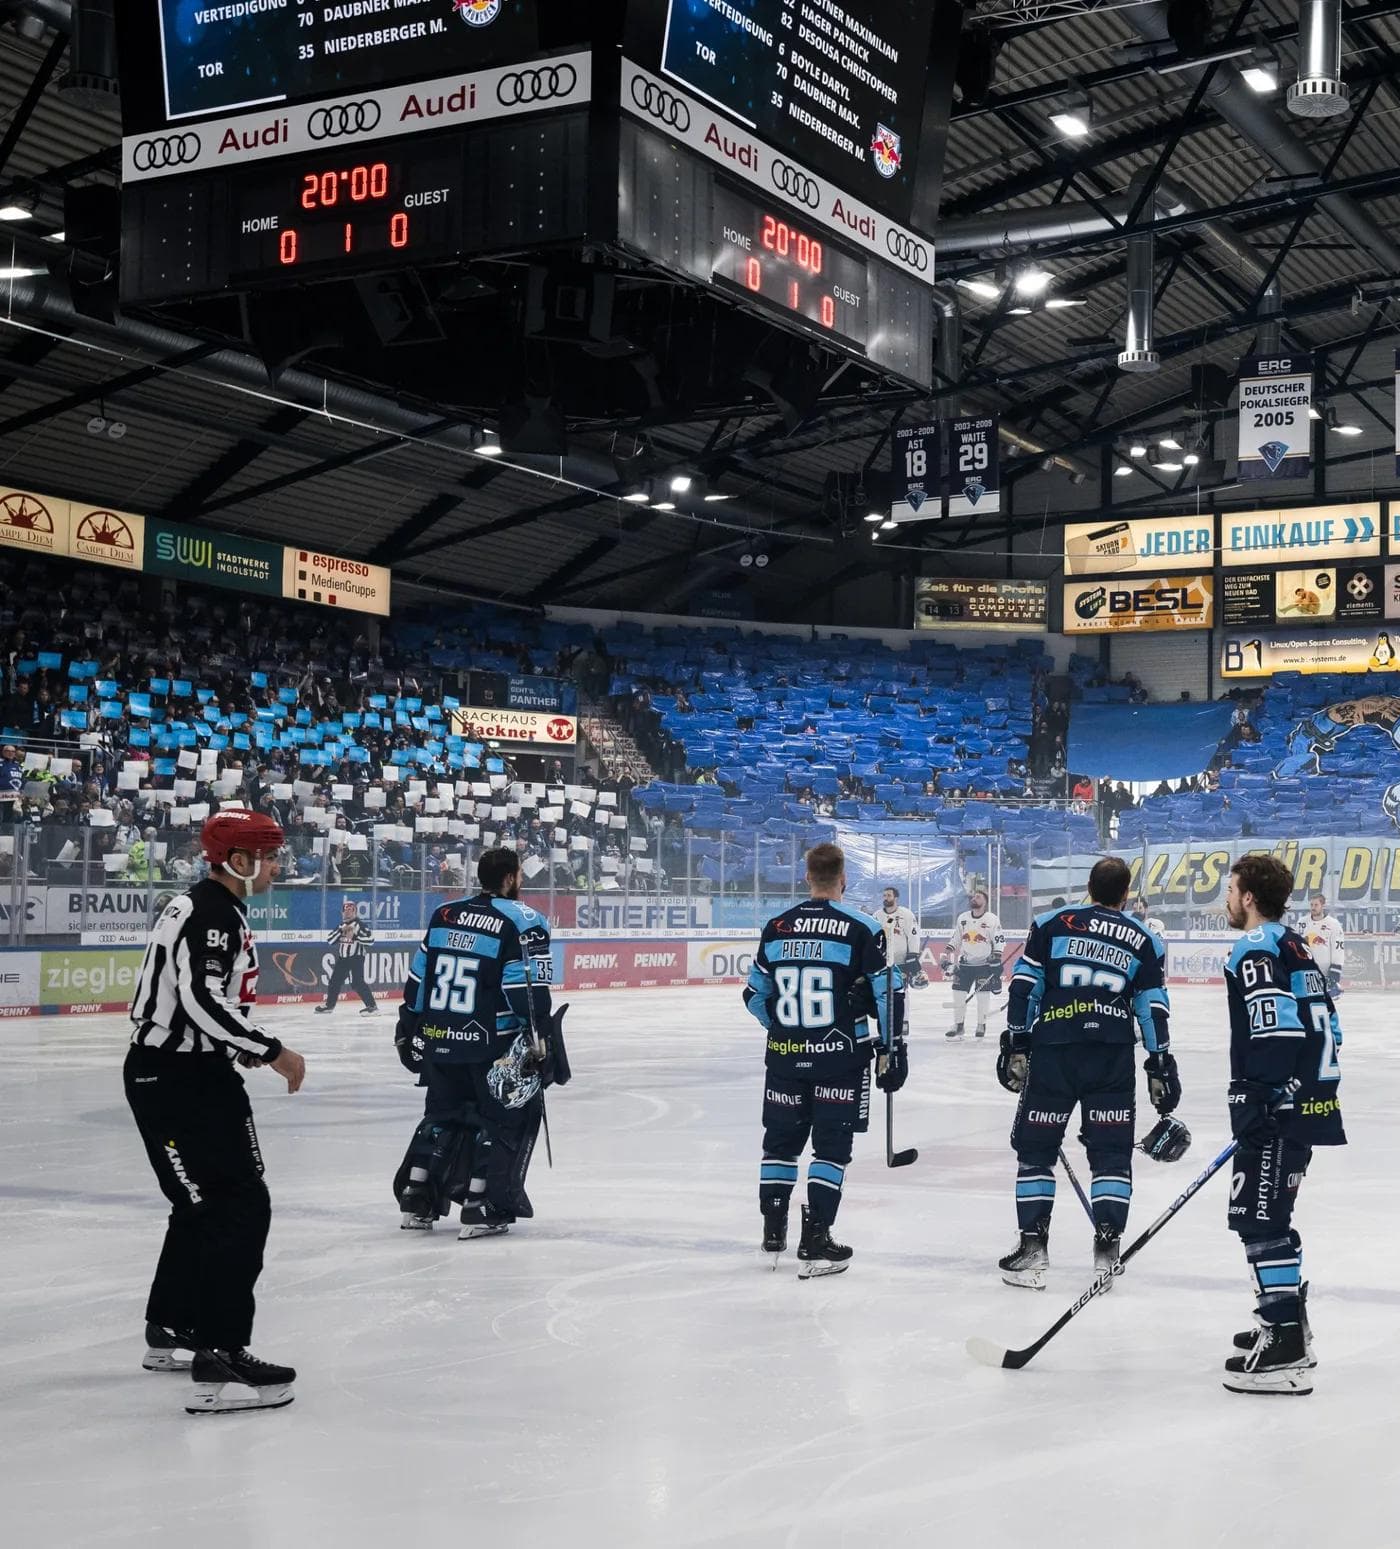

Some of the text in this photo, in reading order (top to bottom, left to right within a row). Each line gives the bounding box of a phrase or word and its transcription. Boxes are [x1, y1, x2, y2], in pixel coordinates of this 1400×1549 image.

[195, 0, 288, 24] VERTEIDIGUNG
[298, 12, 314, 27] 70
[324, 0, 391, 22] DAUBNER
[299, 18, 447, 60] 35 NIEDERBERGER M.
[801, 4, 869, 63] HAGER PATRICK
[845, 14, 898, 64] MAXIMILIAN
[696, 42, 716, 65] TOR
[781, 12, 898, 104] 82 DESOUSA CHRISTOPHER
[198, 61, 224, 78] TOR
[778, 43, 850, 101] 6 BOYLE DARYL
[400, 83, 477, 121] Audi
[776, 63, 861, 129] 70 DAUBNER MAX.
[218, 118, 290, 154] Audi
[771, 91, 866, 162] 35 NIEDERBERGER M.
[704, 123, 758, 172] Audi
[404, 189, 449, 208] GUEST
[242, 216, 279, 234] HOME
[832, 199, 876, 241] Audi
[281, 213, 408, 264] 0 1 0
[724, 226, 751, 250] HOME
[749, 258, 760, 291] 0
[822, 296, 835, 328] 0
[833, 285, 860, 308] GUEST
[1258, 359, 1292, 371] ERC
[1245, 382, 1305, 396] DEUTSCHER
[1240, 396, 1309, 410] POKALSIEGER
[1254, 412, 1294, 427] 2005
[908, 439, 924, 450] AST
[961, 432, 986, 443] WAITE
[905, 450, 927, 478] 18
[959, 443, 988, 472] 29
[1096, 540, 1119, 552] SATURN
[1140, 529, 1210, 557] JEDER
[1231, 520, 1334, 551] EINKAUF
[216, 552, 270, 570] STADTWERKE
[216, 563, 270, 580] INGOLSTADT
[311, 553, 369, 578] espresso
[311, 572, 376, 598] MedienGruppe
[921, 583, 997, 593] Zeit für die
[969, 604, 1046, 612] COMPUTER
[1110, 588, 1203, 613] BESL
[1346, 601, 1375, 609] elements
[1270, 638, 1368, 649] Linux/Open Source Consulting,
[510, 695, 560, 707] PANTHER!
[462, 710, 537, 726] BACKHAUS
[461, 721, 537, 739] Hackner
[1095, 851, 1230, 903] LLES
[69, 894, 147, 913] BRAUN
[100, 921, 147, 931] entsorgen
[458, 911, 504, 934] SATURN
[577, 904, 709, 928] STIEFEL
[794, 918, 849, 936] SATURN
[207, 929, 229, 951] 94
[448, 932, 476, 951] REICH
[995, 935, 1006, 944] 93
[1089, 918, 1146, 950] SATURN
[574, 953, 678, 969] PENNY. PENNY.
[783, 940, 823, 960] PIETTA
[1067, 939, 1131, 970] EDWARDS
[47, 958, 145, 994] ziegler
[321, 952, 409, 985] SURN
[536, 960, 553, 981] 35
[430, 954, 480, 1015] 35
[70, 1004, 102, 1013] PENNY.
[775, 966, 834, 1029] 86
[1044, 999, 1128, 1023] zieglerhaus
[1250, 998, 1278, 1031] 26
[767, 1037, 844, 1055] zieglerhaus
[766, 1085, 855, 1105] CINQUE CINQUE
[1028, 1109, 1130, 1124] CINQUE CINQUE
[164, 1140, 203, 1204] PENNY.
